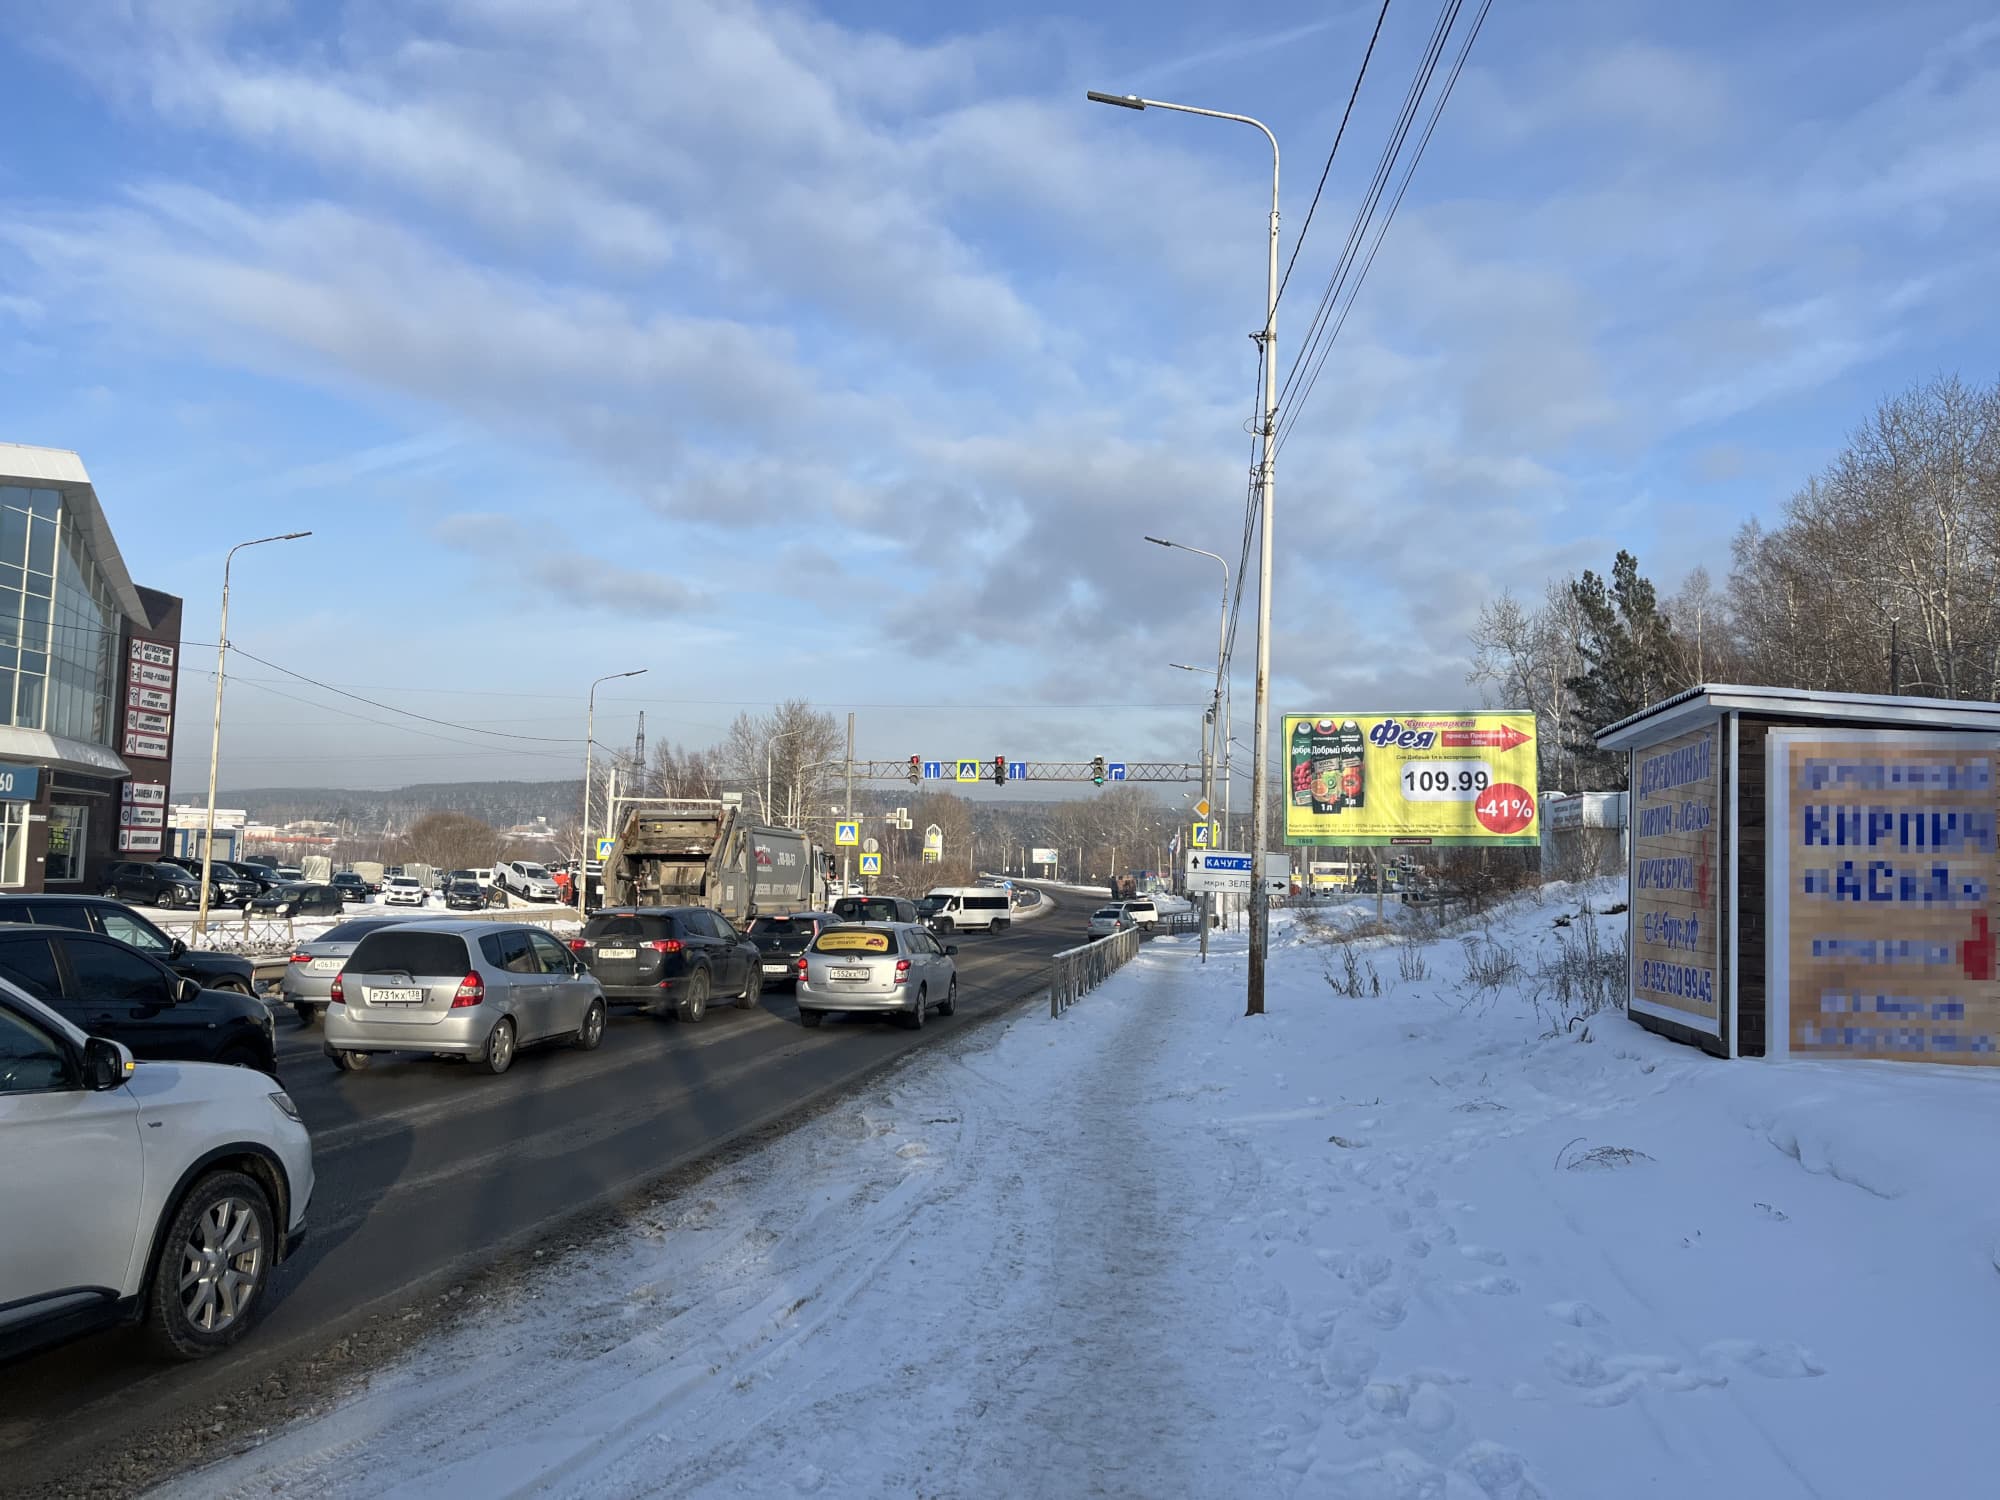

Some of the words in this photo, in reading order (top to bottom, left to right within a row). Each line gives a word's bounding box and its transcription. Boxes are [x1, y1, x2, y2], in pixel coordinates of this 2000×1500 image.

[1369, 720, 1434, 748] Фея
[1311, 745, 1340, 756] Добрый
[1640, 735, 1711, 801] ДЕРЕВЯННЫЙ
[1404, 771, 1488, 791] 109.99
[1477, 799, 1533, 818] -41%
[1207, 860, 1238, 868] КАЧУГ
[1638, 858, 1665, 889] КРУЧЕ
[1666, 856, 1693, 889] БРУСА
